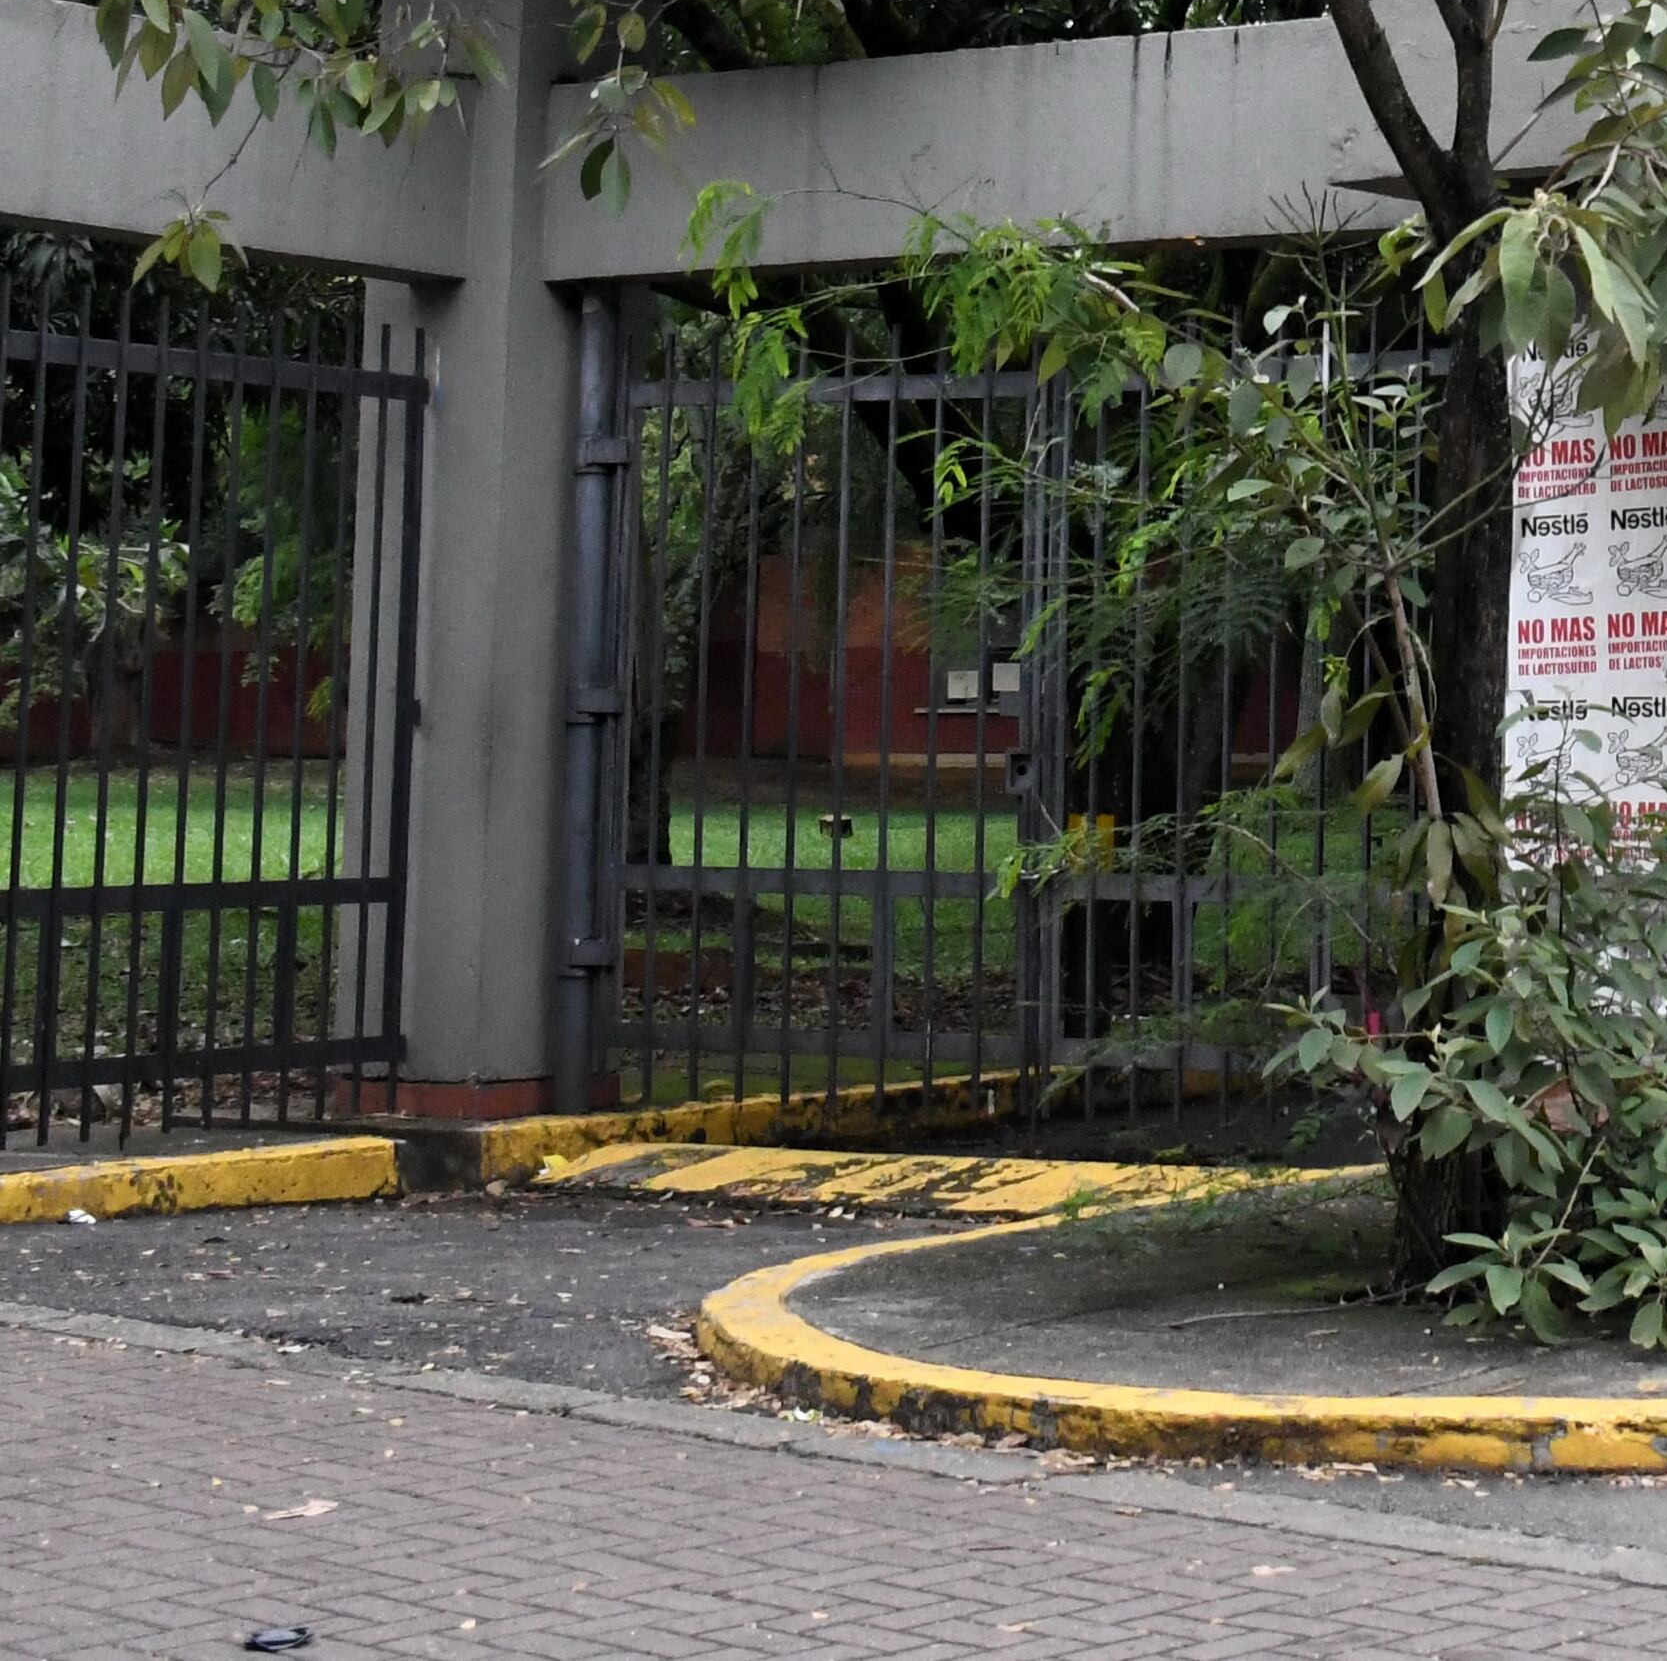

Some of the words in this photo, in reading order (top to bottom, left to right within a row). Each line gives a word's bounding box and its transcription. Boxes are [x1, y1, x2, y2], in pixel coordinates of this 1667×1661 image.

[1551, 438, 1596, 465] MAS
[1610, 434, 1636, 460] NO
[1518, 467, 1595, 483] IMPORTACIONE
[1518, 486, 1530, 499] DE
[1611, 480, 1621, 492] DE
[1521, 513, 1589, 538] Nestlé
[1518, 619, 1544, 644] NO
[1551, 616, 1595, 642] MAS
[1608, 612, 1635, 638] NO
[1518, 645, 1596, 660] IMPORTACIONES
[1518, 664, 1530, 676] DE
[1533, 661, 1597, 676] LACTOSUERO
[1609, 658, 1621, 670] DE
[1624, 656, 1663, 669] LACTOS
